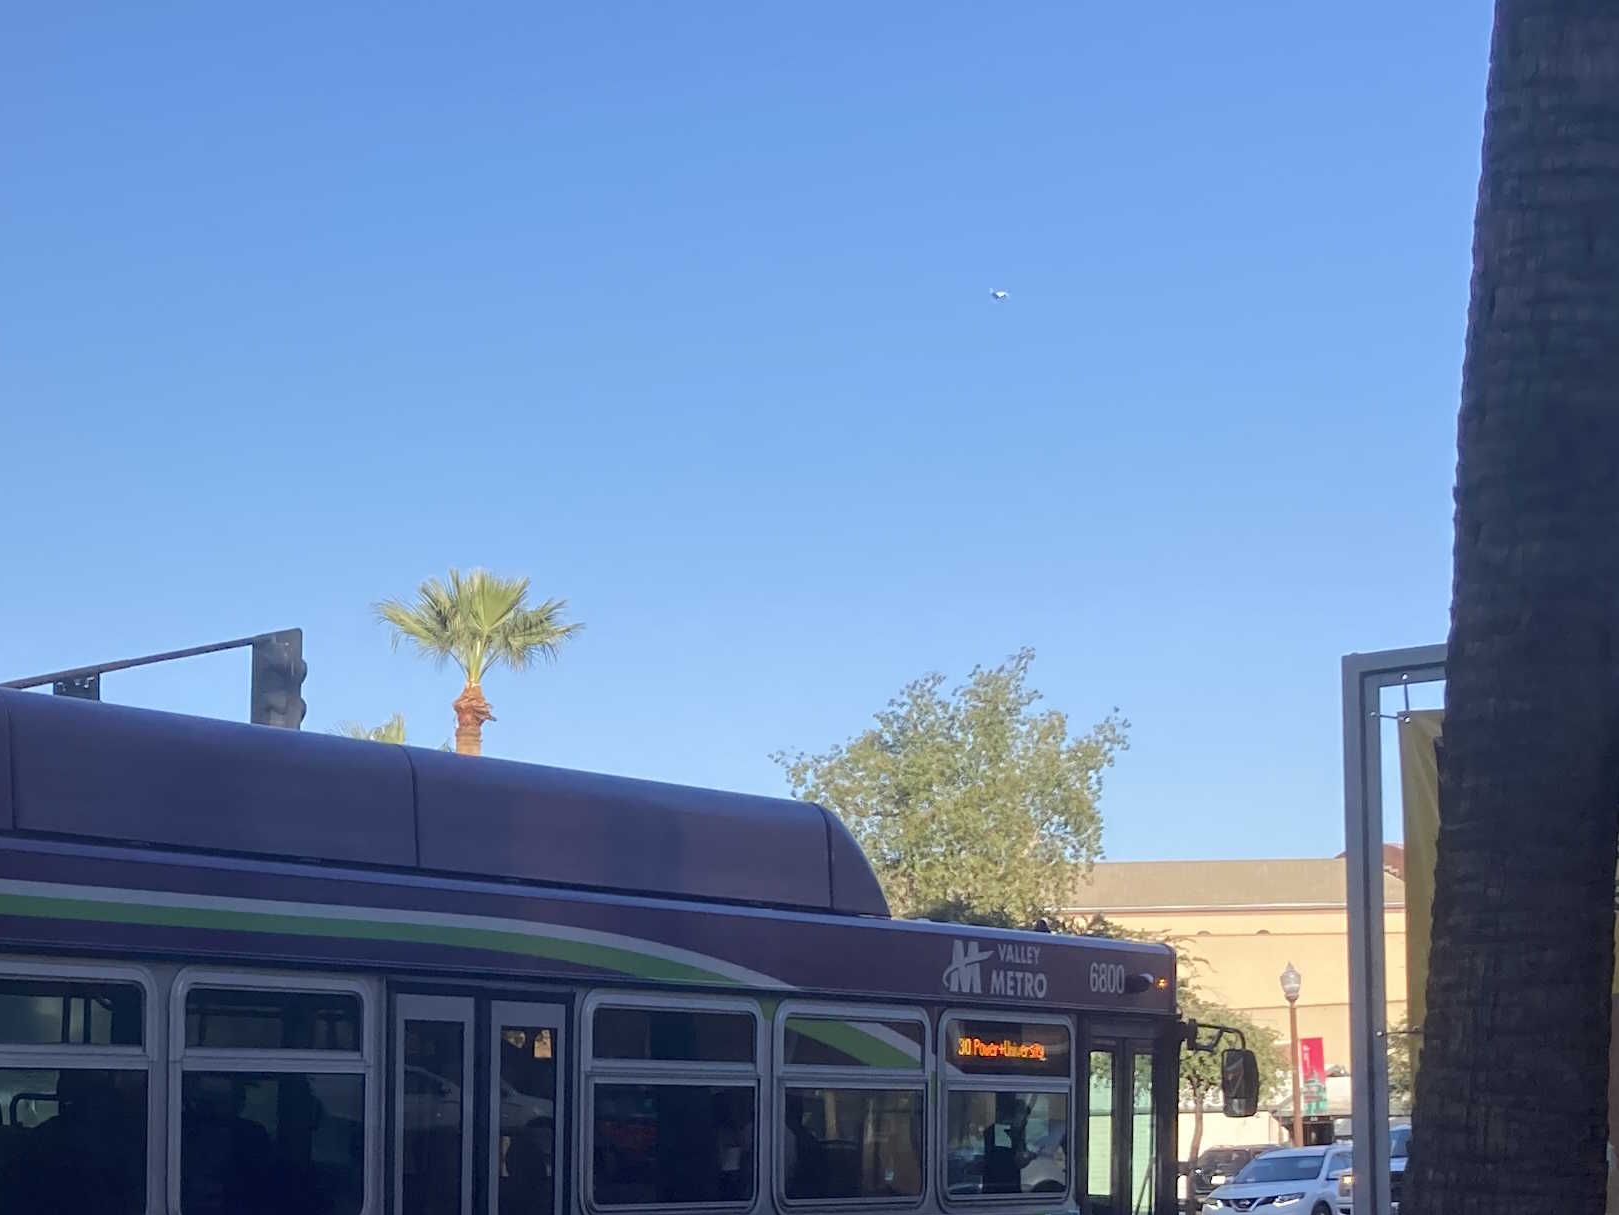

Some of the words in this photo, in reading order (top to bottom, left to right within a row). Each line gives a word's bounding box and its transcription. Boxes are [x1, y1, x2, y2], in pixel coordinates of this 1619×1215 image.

[997, 943, 1042, 964] VALLEY
[989, 969, 1048, 998] METRO
[1089, 961, 1125, 994] 6800
[957, 1037, 972, 1056] 30
